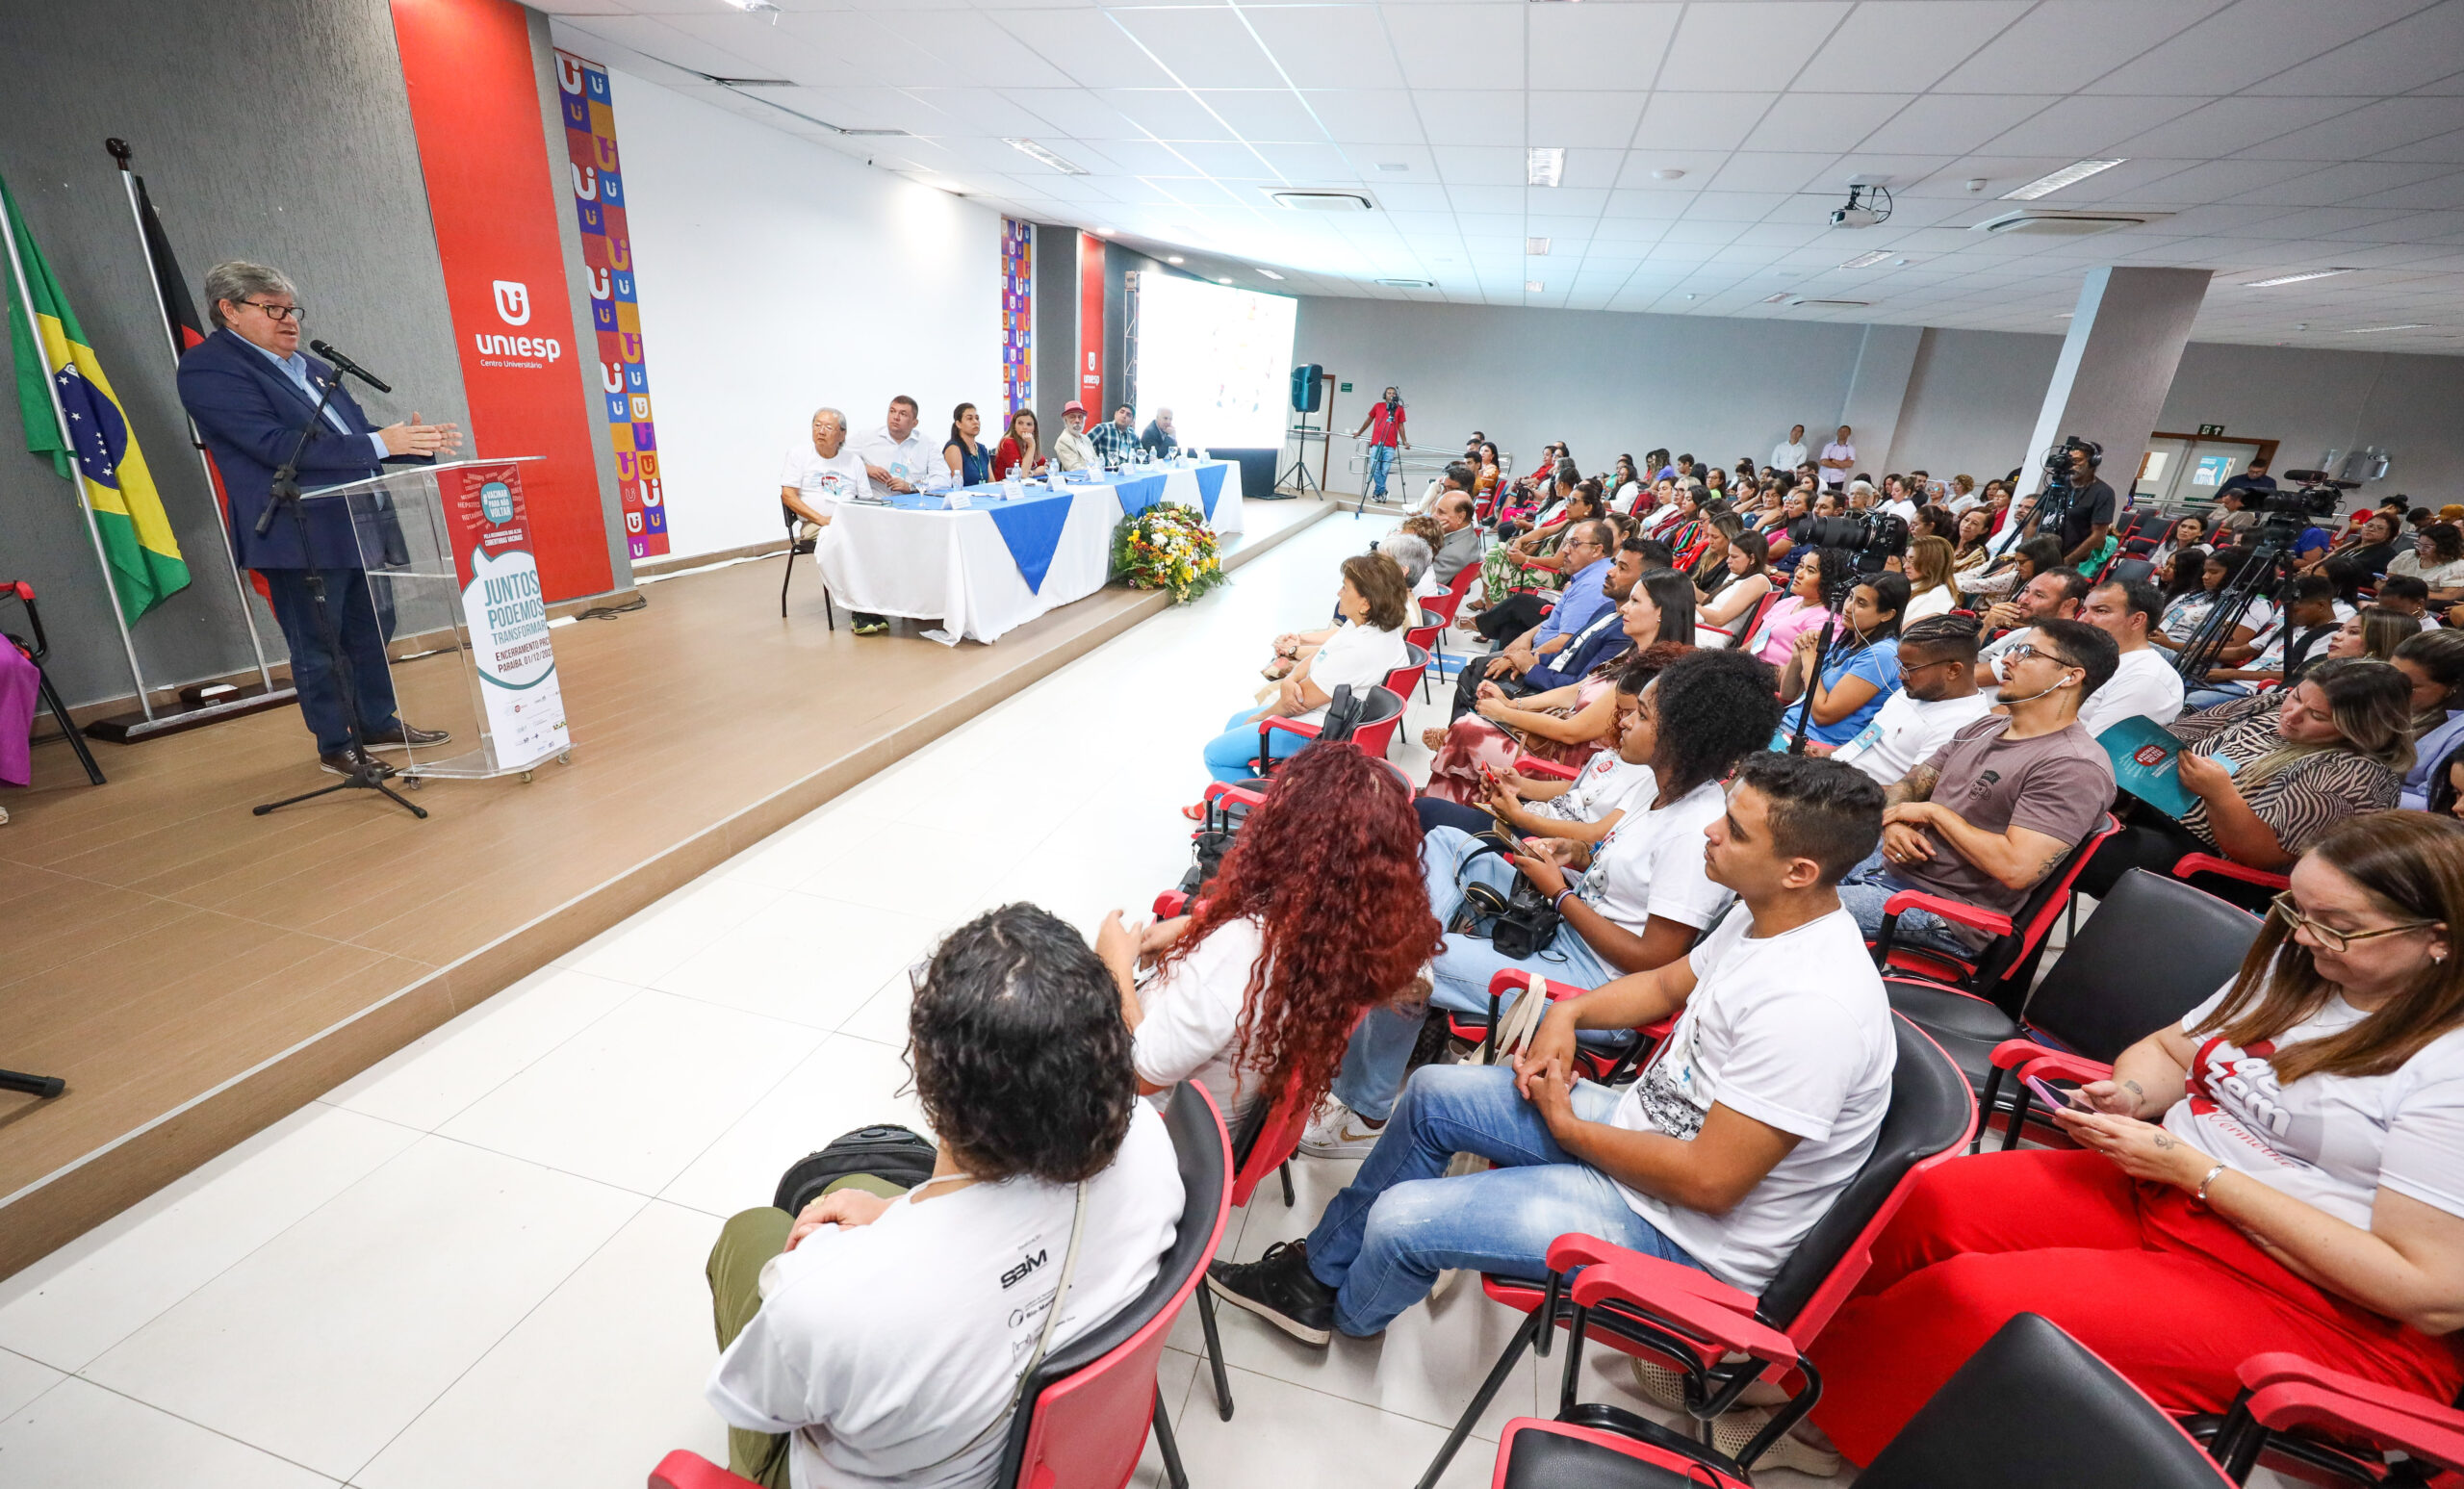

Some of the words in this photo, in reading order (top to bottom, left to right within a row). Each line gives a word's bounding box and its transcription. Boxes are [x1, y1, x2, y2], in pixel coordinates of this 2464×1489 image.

[475, 334, 561, 363] uniesp
[480, 359, 502, 368] Centro
[503, 360, 543, 369] Universitário
[490, 506, 511, 518] VOLTAR
[484, 570, 540, 606] JUNTOS
[487, 598, 545, 629] PODEMOS
[496, 641, 540, 661] ENCERRAMENTO
